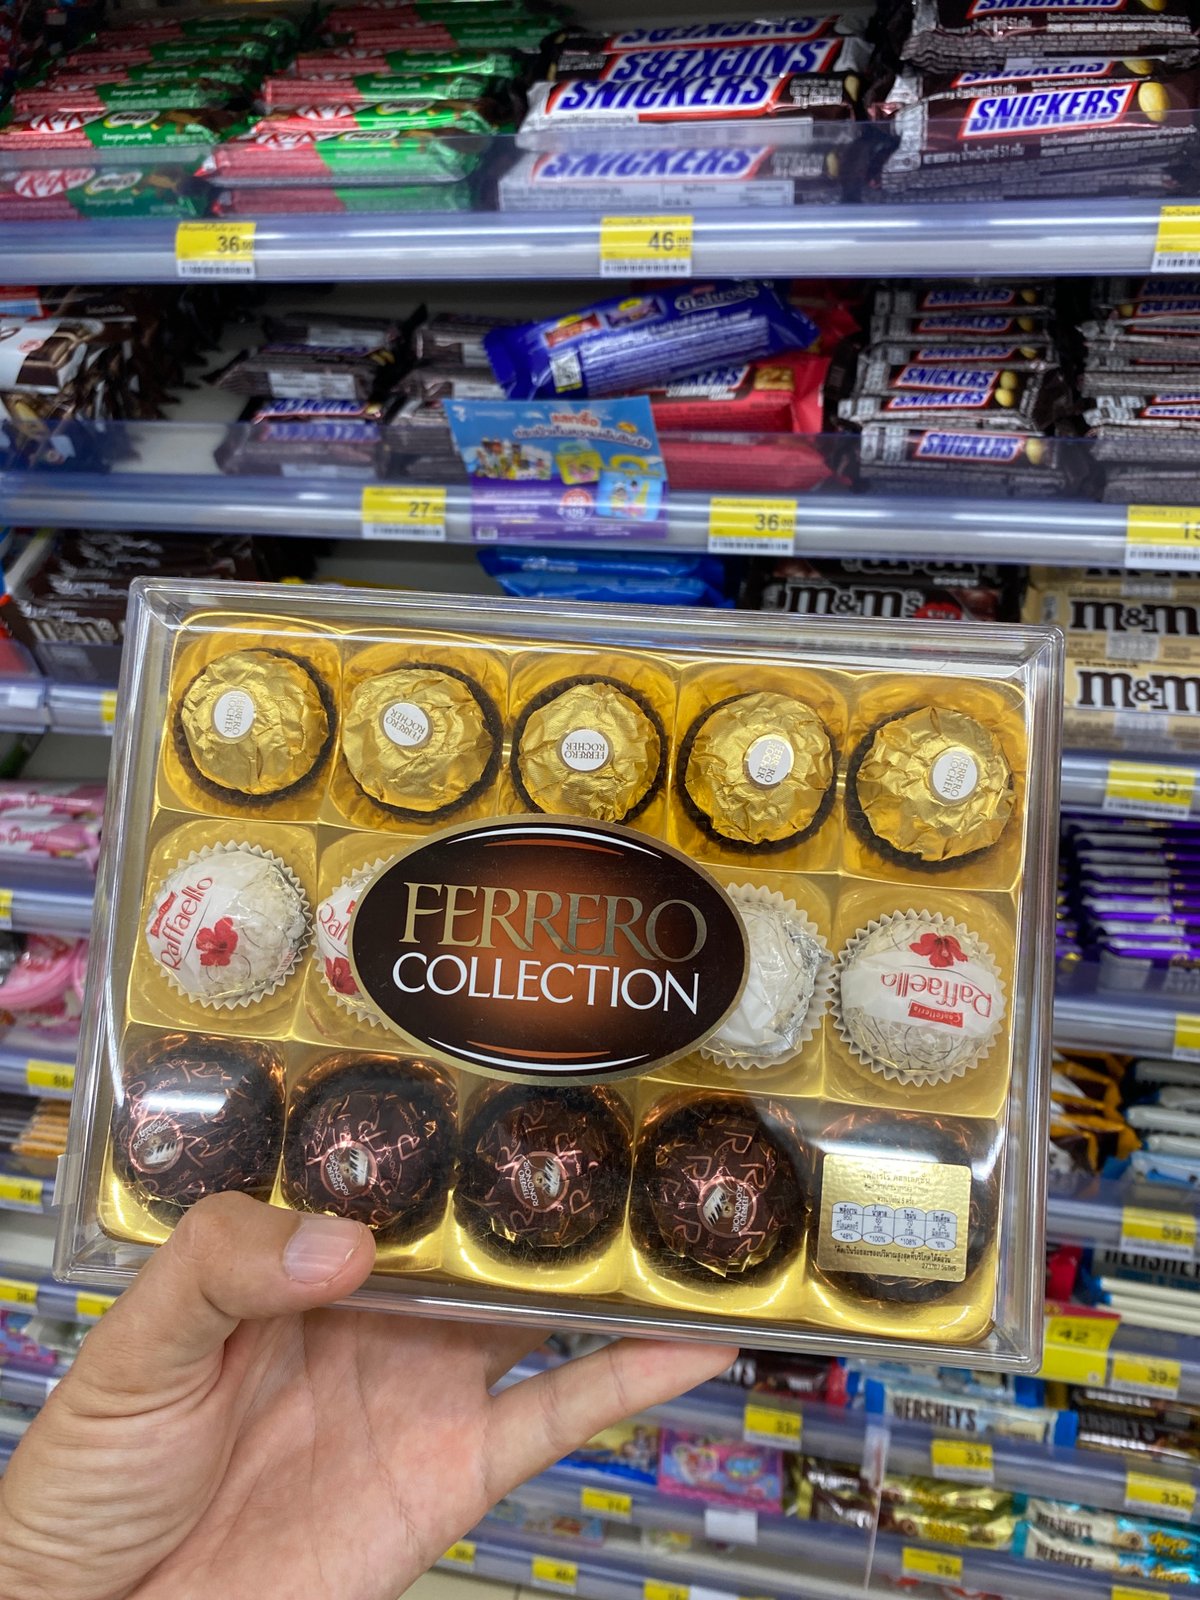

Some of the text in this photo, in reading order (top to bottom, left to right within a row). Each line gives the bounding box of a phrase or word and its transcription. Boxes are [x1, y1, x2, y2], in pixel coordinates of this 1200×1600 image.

[560, 75, 771, 110] SNICKERS
[969, 88, 1126, 132] SNICKERS
[217, 235, 240, 253] 36
[649, 231, 675, 252] 46
[902, 368, 994, 389] SNICKERS
[409, 501, 430, 518] 27
[754, 513, 779, 531] 36
[385, 716, 422, 742] FERRERO
[390, 708, 426, 735] ROCHER
[564, 751, 605, 760] FERRERO
[565, 742, 606, 752] ROCHER
[942, 755, 961, 794] ROCHER
[950, 757, 970, 797] FERRERO
[1152, 779, 1177, 798] 39
[160, 877, 214, 970] Raffaello
[399, 881, 708, 963] FERRERO
[392, 951, 700, 1016] COLLECTION
[881, 972, 993, 1018] Raffaello
[523, 1161, 540, 1207] RONDNOIR
[730, 1184, 743, 1233] RONDNOIR
